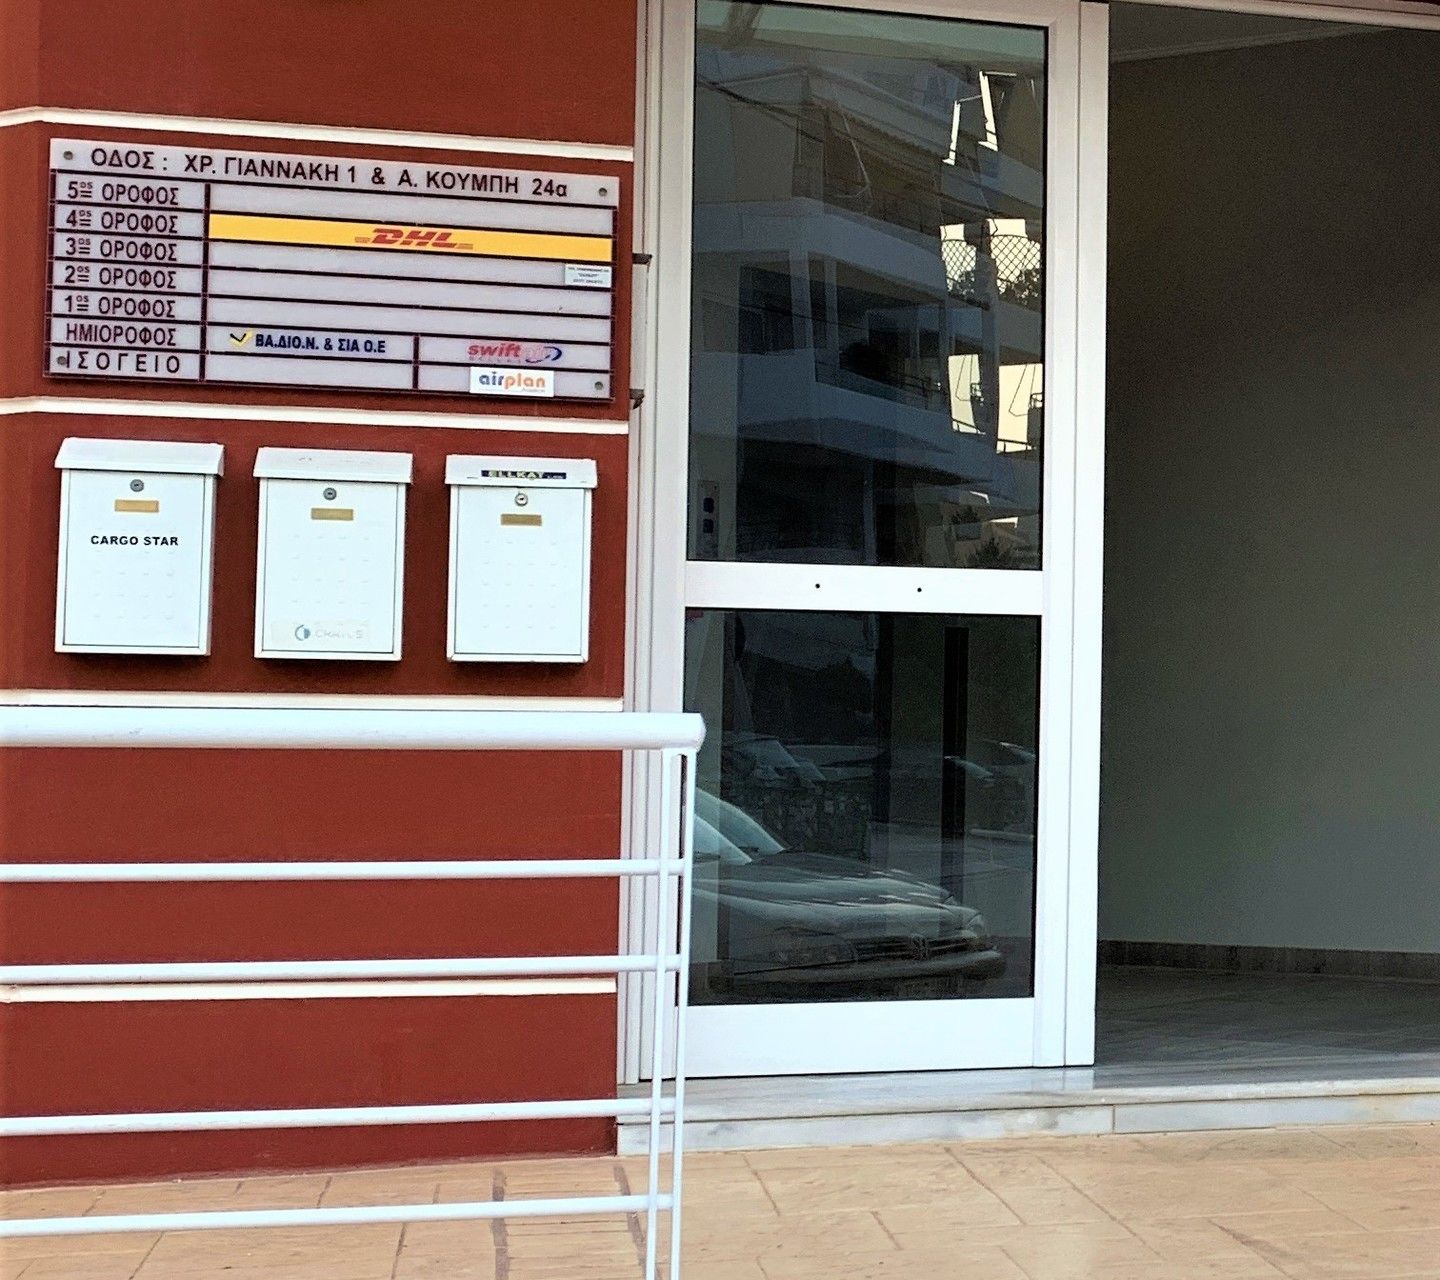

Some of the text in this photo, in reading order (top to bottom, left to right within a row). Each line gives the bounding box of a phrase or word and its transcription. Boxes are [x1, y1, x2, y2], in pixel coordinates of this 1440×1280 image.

[184, 154, 216, 174] ΧΡ.
[224, 157, 339, 181] ΓΙΑΝΝΑΚΗ
[347, 166, 356, 183] 1
[371, 167, 386, 185] &
[398, 169, 418, 188] Α.
[426, 171, 519, 194] ΚΟΥΜΠΗ
[102, 183, 179, 205] ΟΡΟΦΟΣ
[101, 211, 178, 233] ΟΡΟΦΟΣ
[369, 227, 458, 248] DHL
[100, 239, 177, 261] ΟΡΟΦΟΣ
[99, 267, 177, 289] ΟΡΟΦΟΣ
[98, 296, 176, 318] ΟΡΟΦΟΣ
[66, 323, 177, 346] ΗΜΙΟΡΟΦΟΣ
[323, 338, 333, 351] &
[338, 338, 360, 352] ΣΙΑ
[66, 350, 180, 373] ΙΣΟΓΕΙΟ
[478, 371, 546, 389] airplan
[90, 535, 179, 546] CARGO STAR
